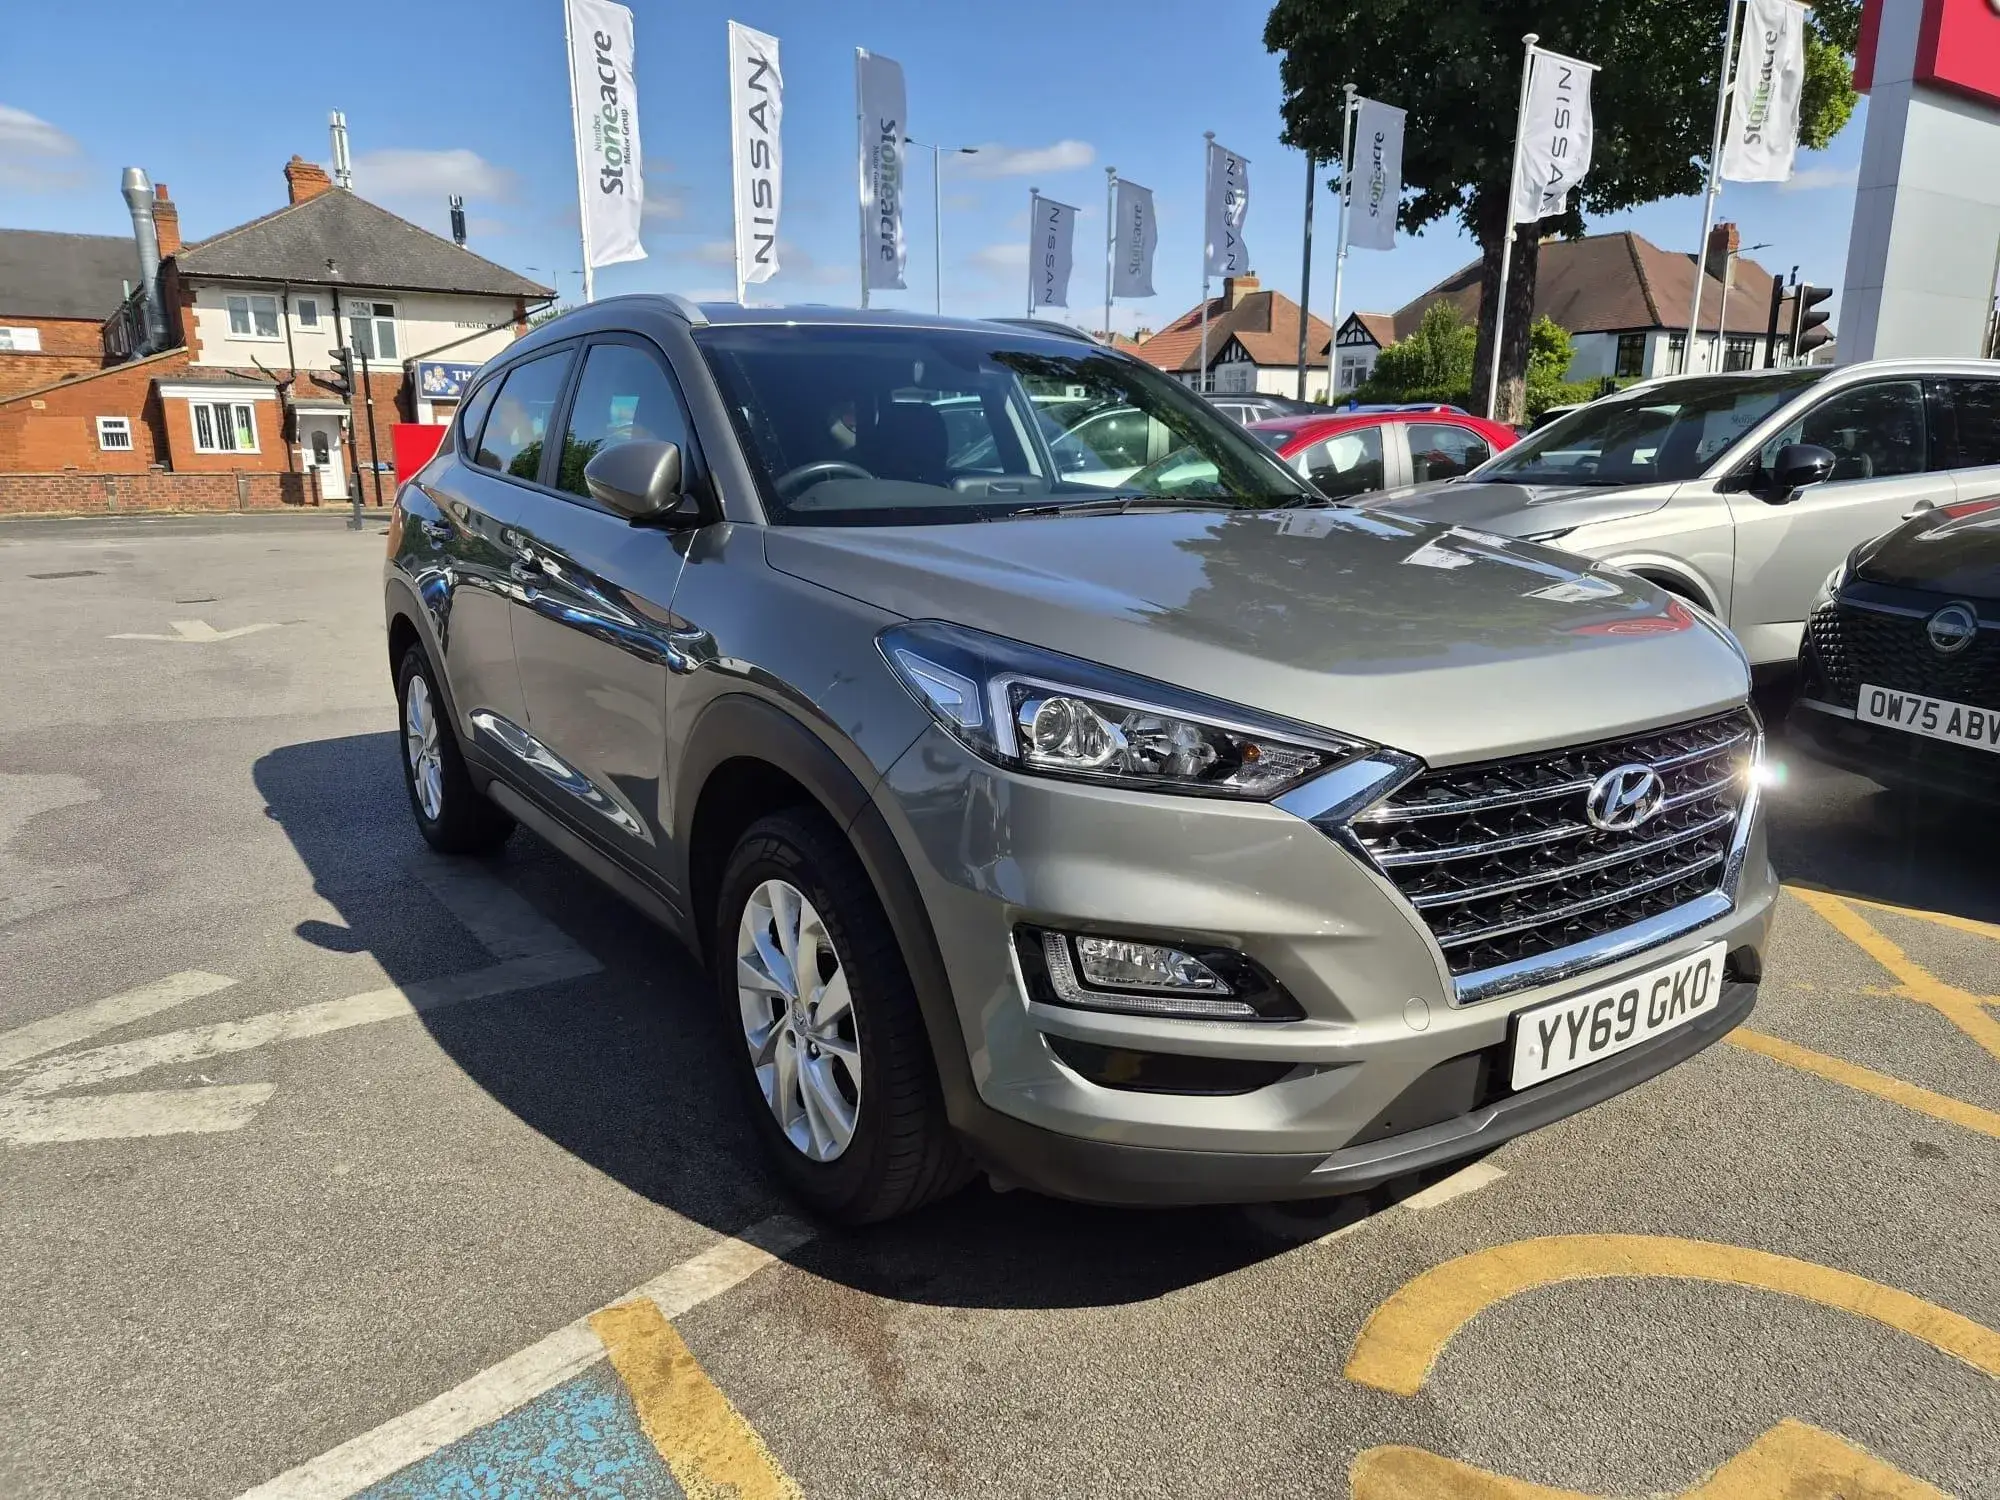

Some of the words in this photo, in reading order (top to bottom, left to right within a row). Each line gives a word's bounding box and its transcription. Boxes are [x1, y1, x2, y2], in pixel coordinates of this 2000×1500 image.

[593, 114, 602, 152] Number
[594, 30, 624, 195] Stoneacre
[621, 109, 629, 136] Group
[1743, 30, 1778, 145] Stoneacre
[622, 136, 631, 165] Motor
[747, 55, 775, 264] NISSAN
[880, 117, 897, 262] Stoneacre
[1369, 131, 1385, 218] Stoneacre
[1045, 207, 1060, 303] NISSAN
[1225, 158, 1236, 271] NISSAN
[452, 370, 473, 381] TH
[1870, 690, 1940, 730] OW75
[1538, 988, 1640, 1070] YY69
[1647, 958, 1712, 1029] GKO
